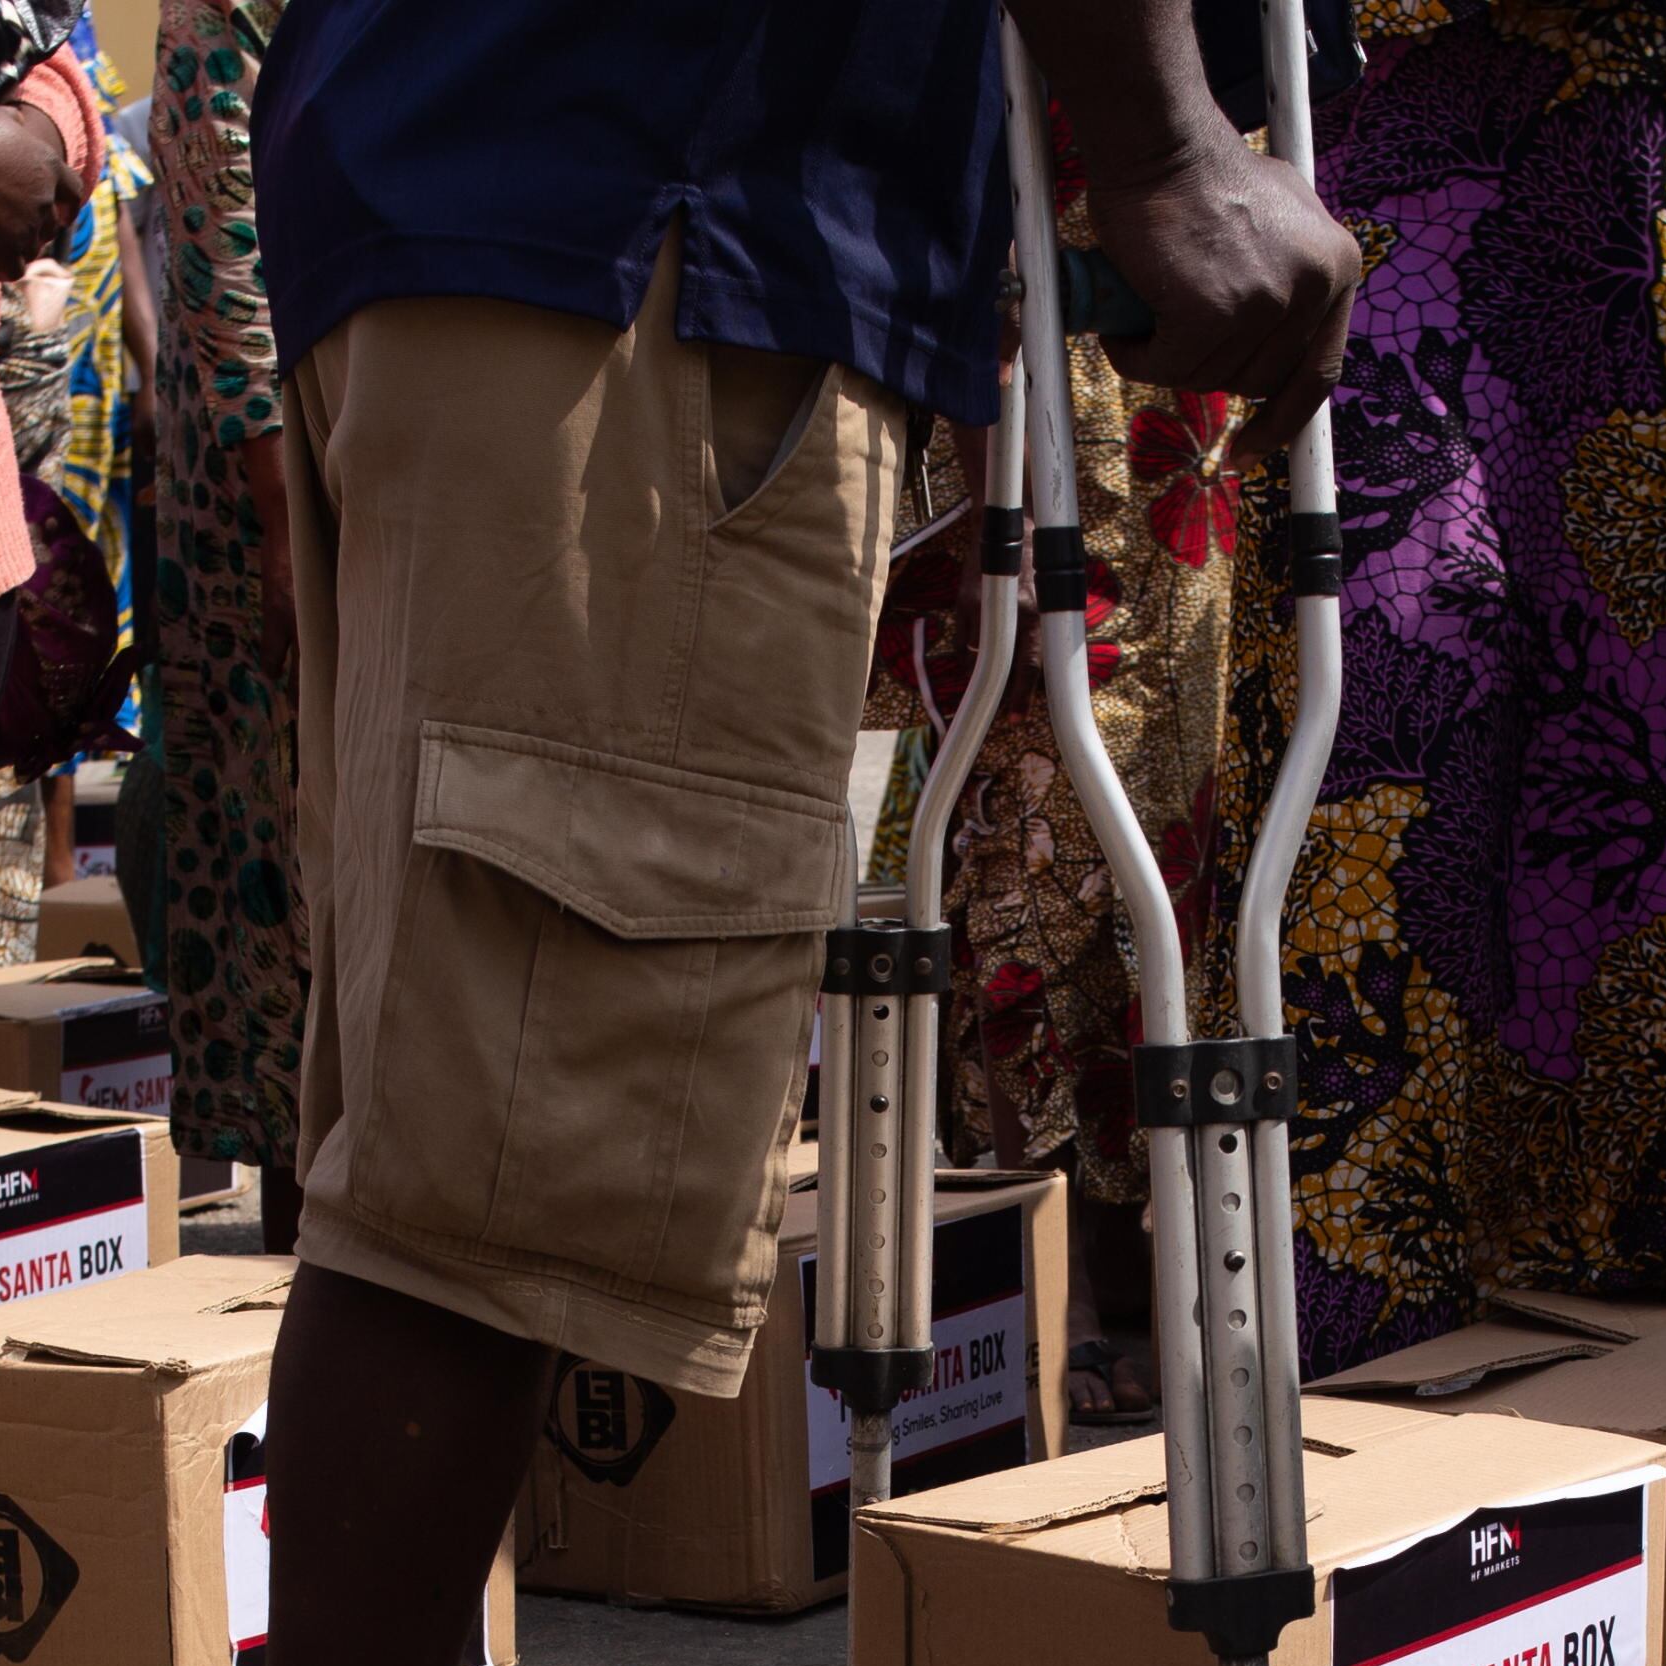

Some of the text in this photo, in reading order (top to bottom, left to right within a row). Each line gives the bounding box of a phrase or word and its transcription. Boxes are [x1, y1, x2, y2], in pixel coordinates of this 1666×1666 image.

[79, 1235, 123, 1280] BOX
[970, 1330, 1006, 1381] BOX
[940, 1399, 979, 1425] Sharing
[980, 1390, 1003, 1410] Love
[1470, 1515, 1520, 1567] HFM
[1470, 1555, 1520, 1582] HF MARKETS
